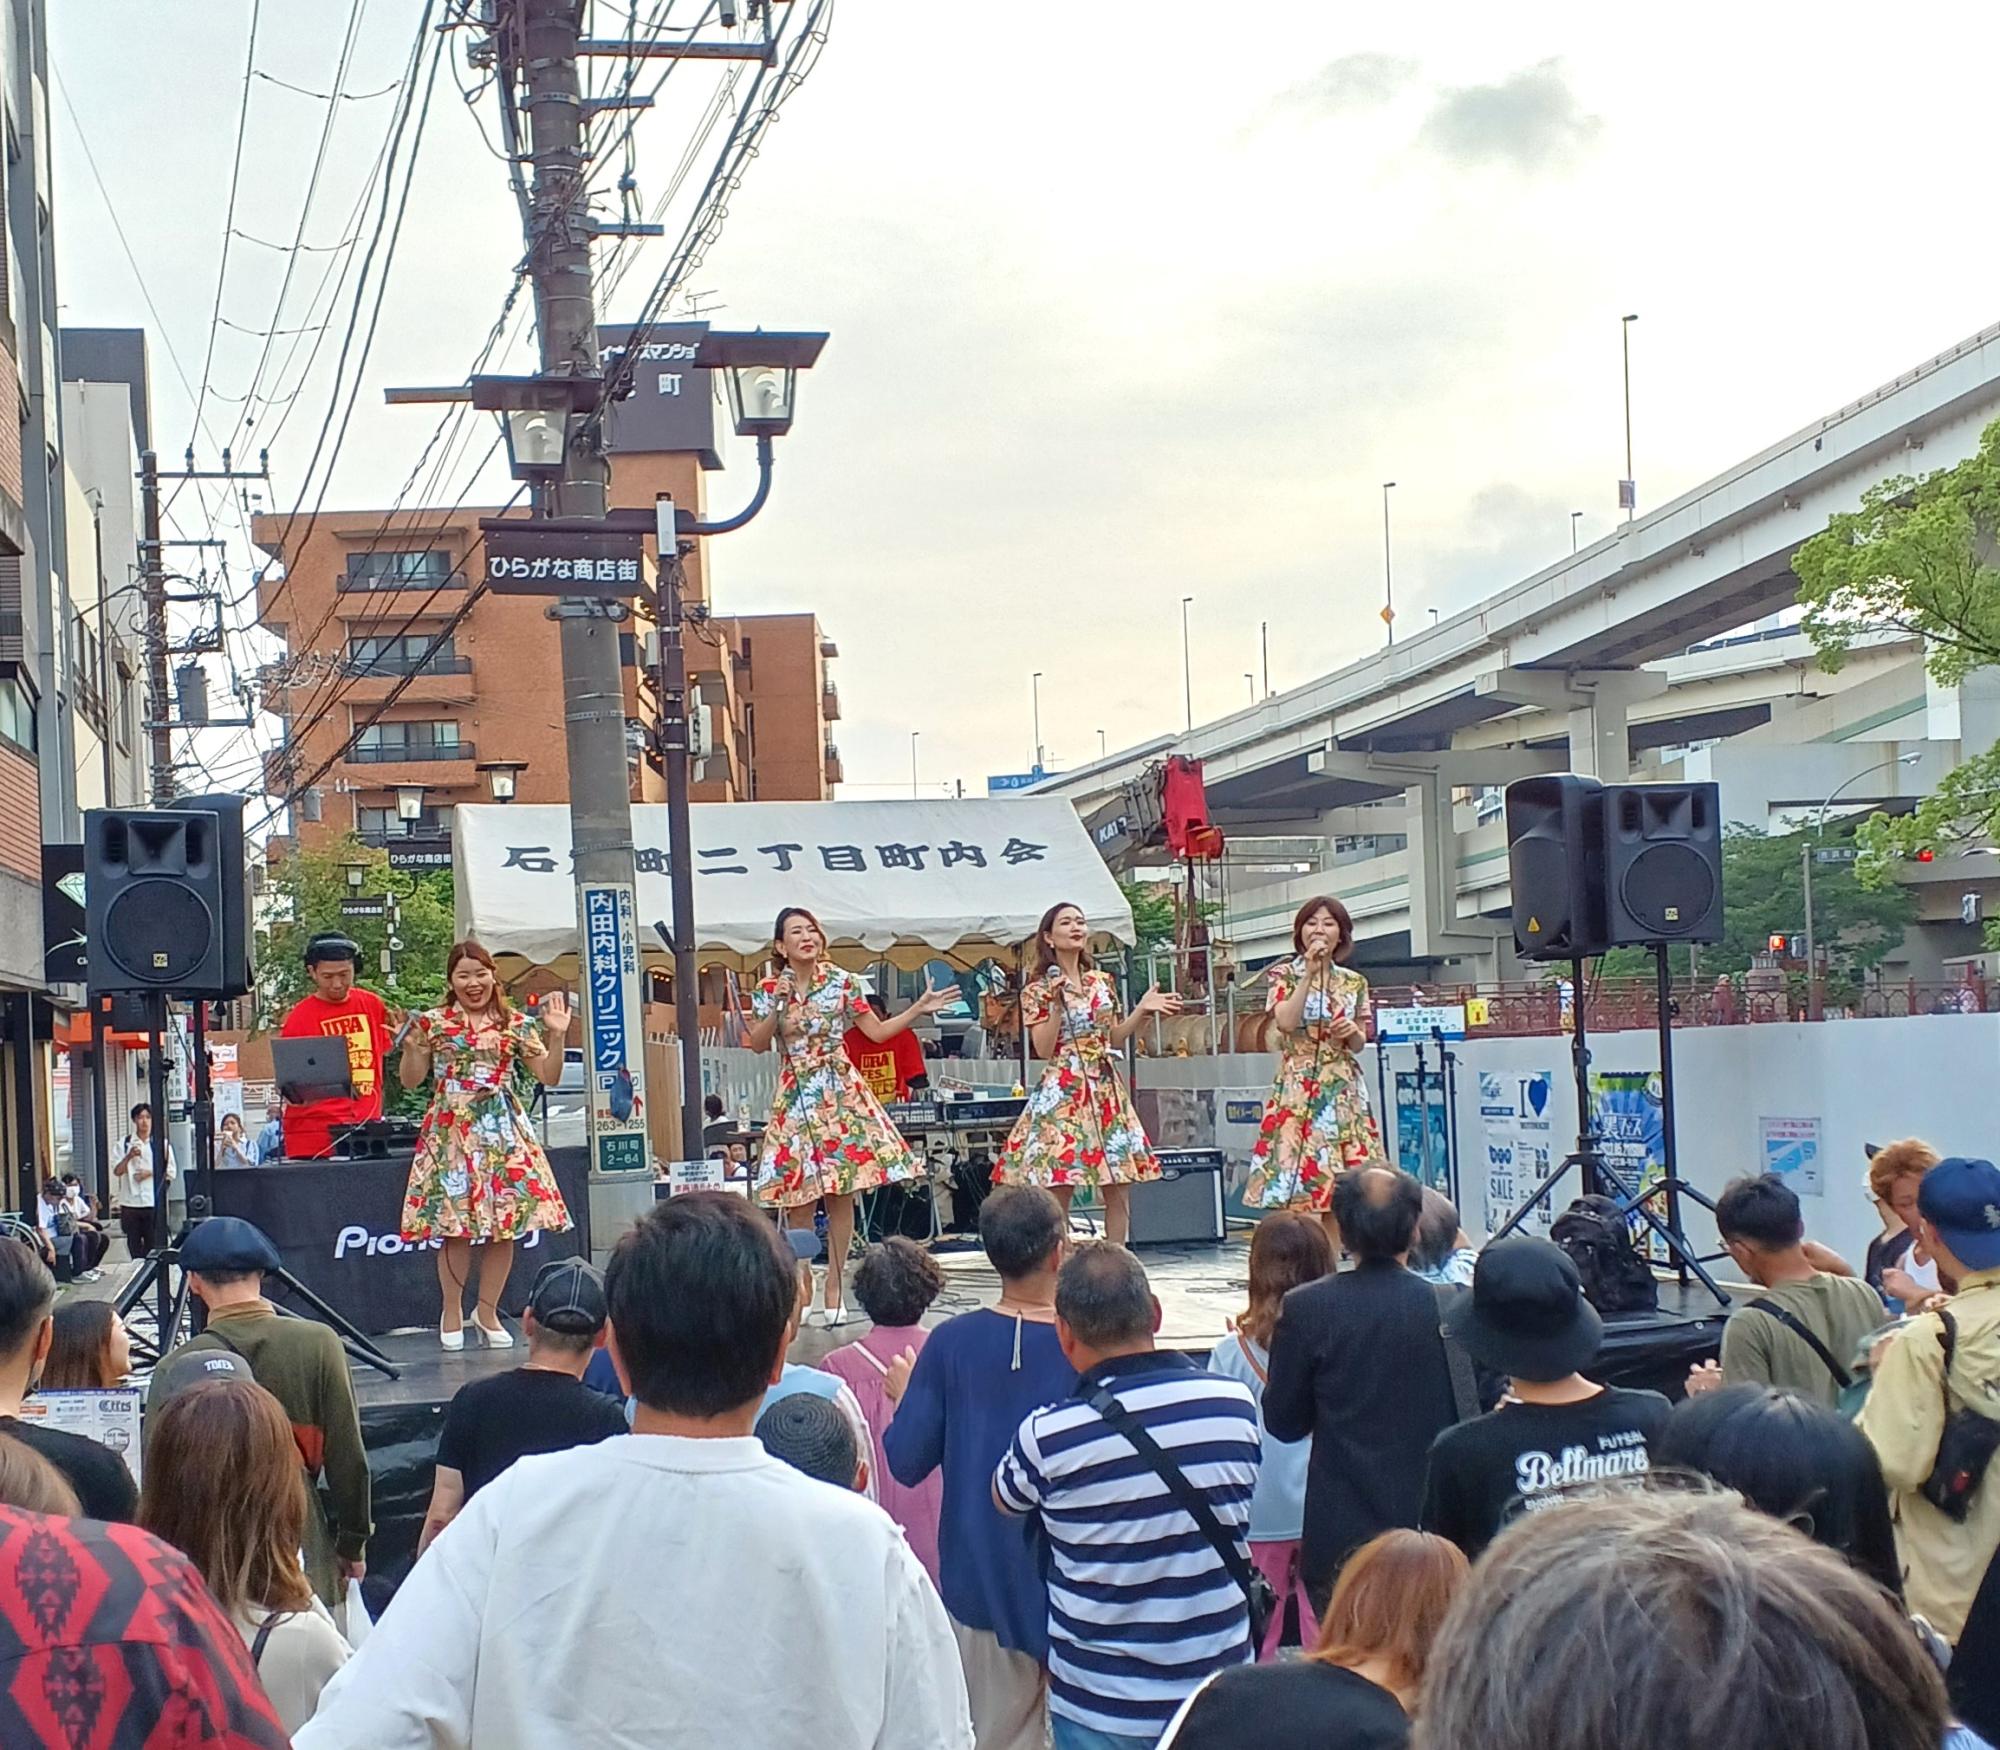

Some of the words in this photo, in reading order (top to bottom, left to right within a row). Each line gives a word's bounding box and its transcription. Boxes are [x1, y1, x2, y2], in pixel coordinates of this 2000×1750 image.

[489, 556, 639, 582] ひらがな商店街
[390, 853, 452, 865] ひらがな商店街
[501, 838, 1048, 877] 石町二丁目町内会
[619, 888, 636, 975] 内科・小児科
[590, 892, 622, 1069] 内田内科クリニック
[1490, 1178, 1514, 1201] SALE
[1597, 1430, 1648, 1450] FUTSAL
[1515, 1445, 1650, 1495] Bellmare
